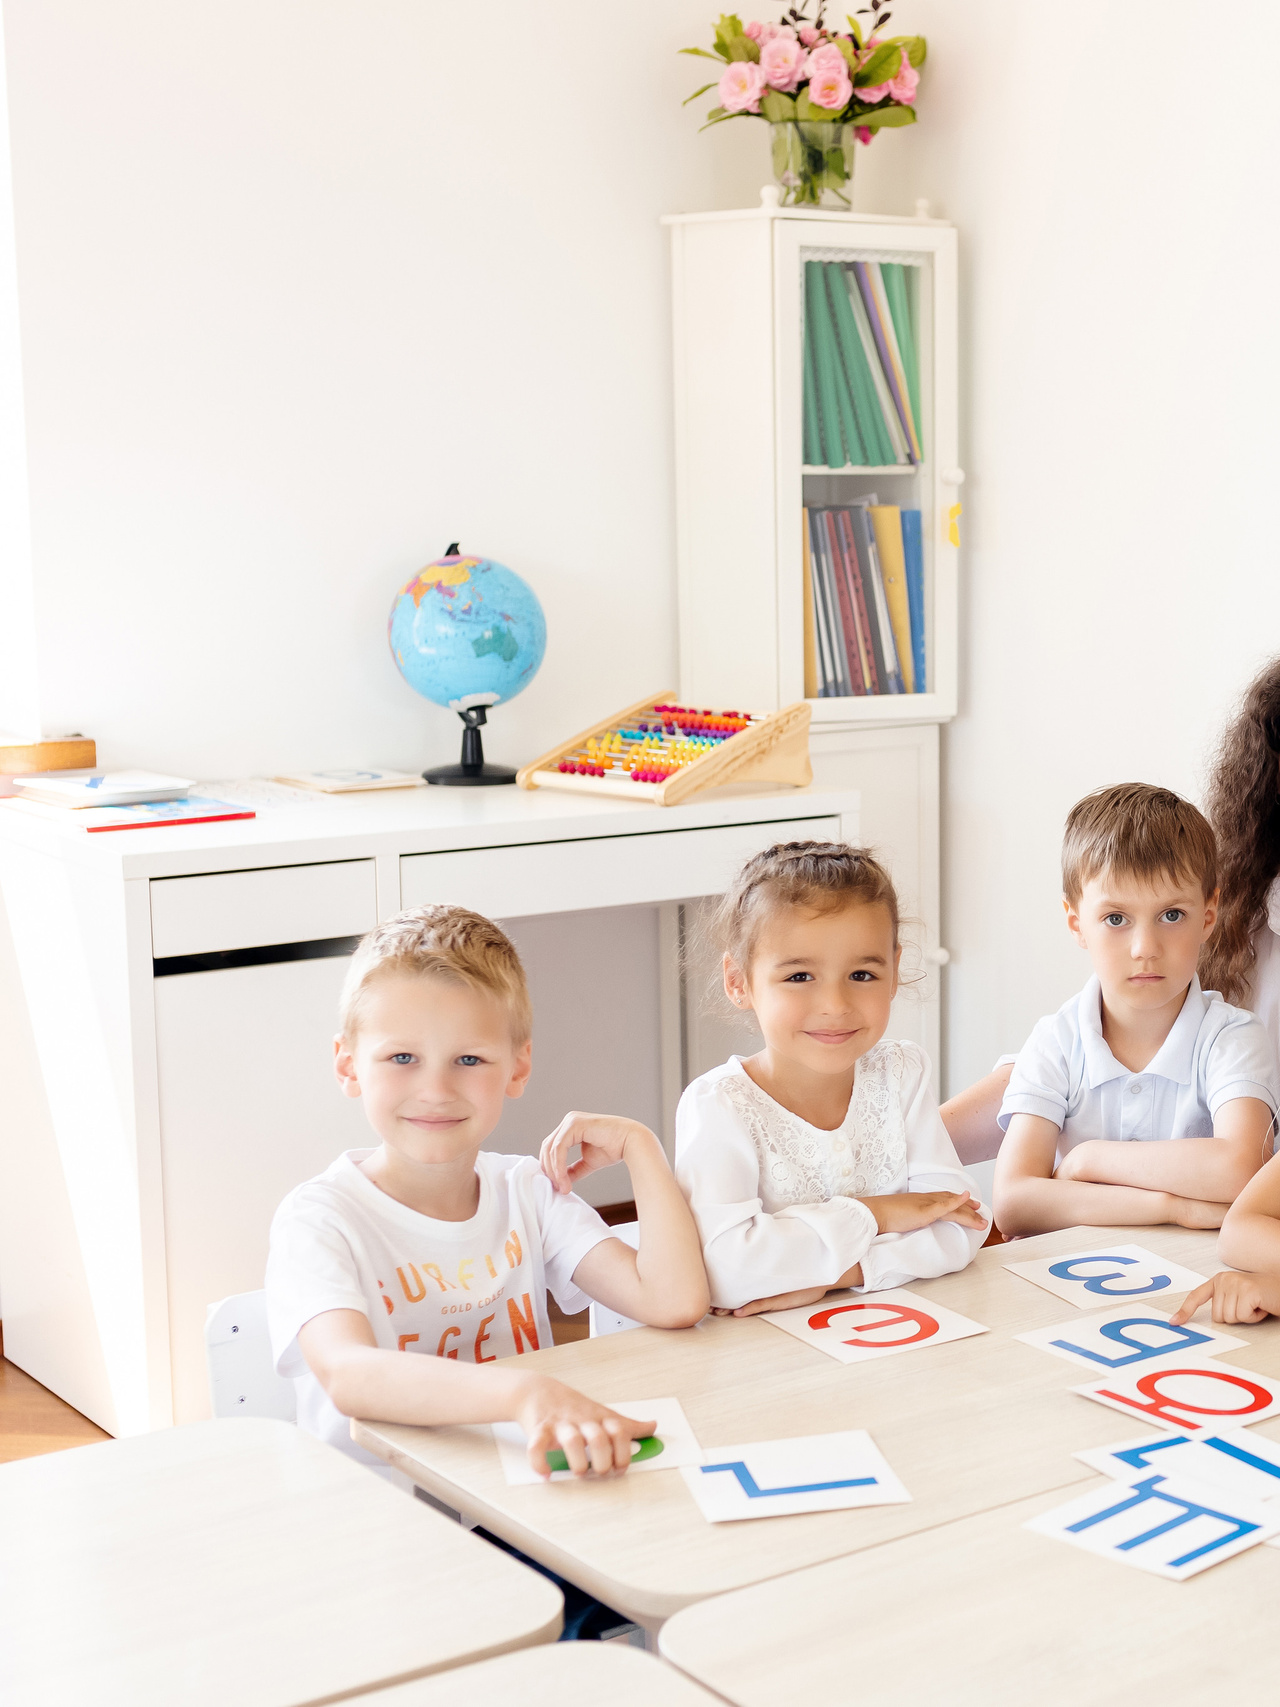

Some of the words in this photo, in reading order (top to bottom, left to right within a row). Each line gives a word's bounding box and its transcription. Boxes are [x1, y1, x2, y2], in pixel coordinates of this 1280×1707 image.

[440, 1302, 472, 1315] GOLD
[477, 1286, 505, 1309] COAST
[1096, 1369, 1273, 1430] Ю
